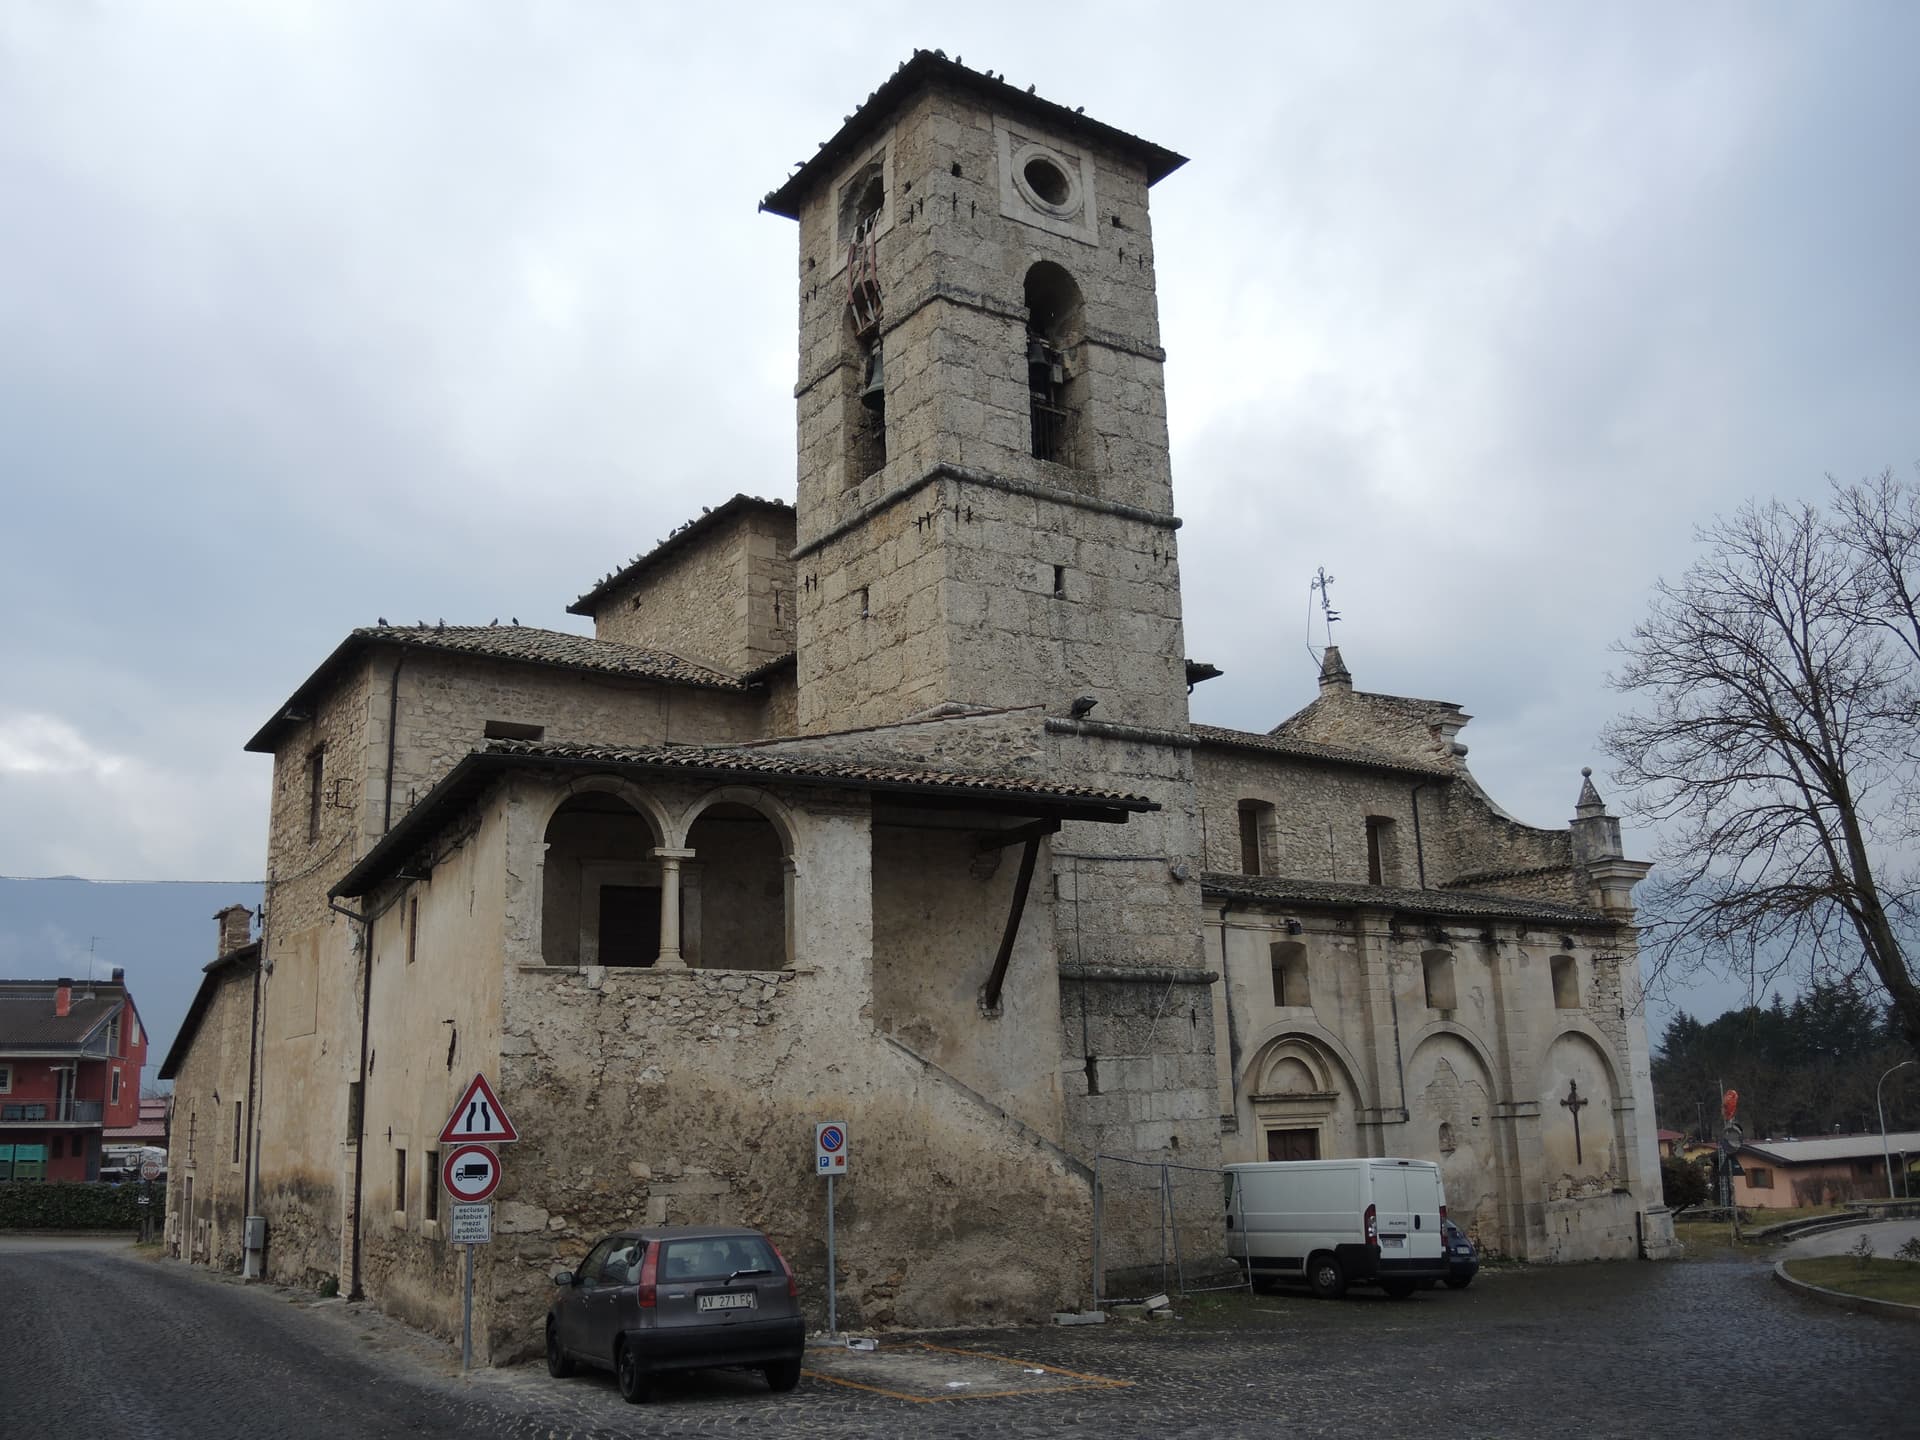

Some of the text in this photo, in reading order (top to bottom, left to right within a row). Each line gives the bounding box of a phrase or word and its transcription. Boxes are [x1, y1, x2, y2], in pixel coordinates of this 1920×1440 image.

[143, 1166, 159, 1176] STOP
[702, 1296, 713, 1308] AV
[720, 1295, 736, 1307] 271
